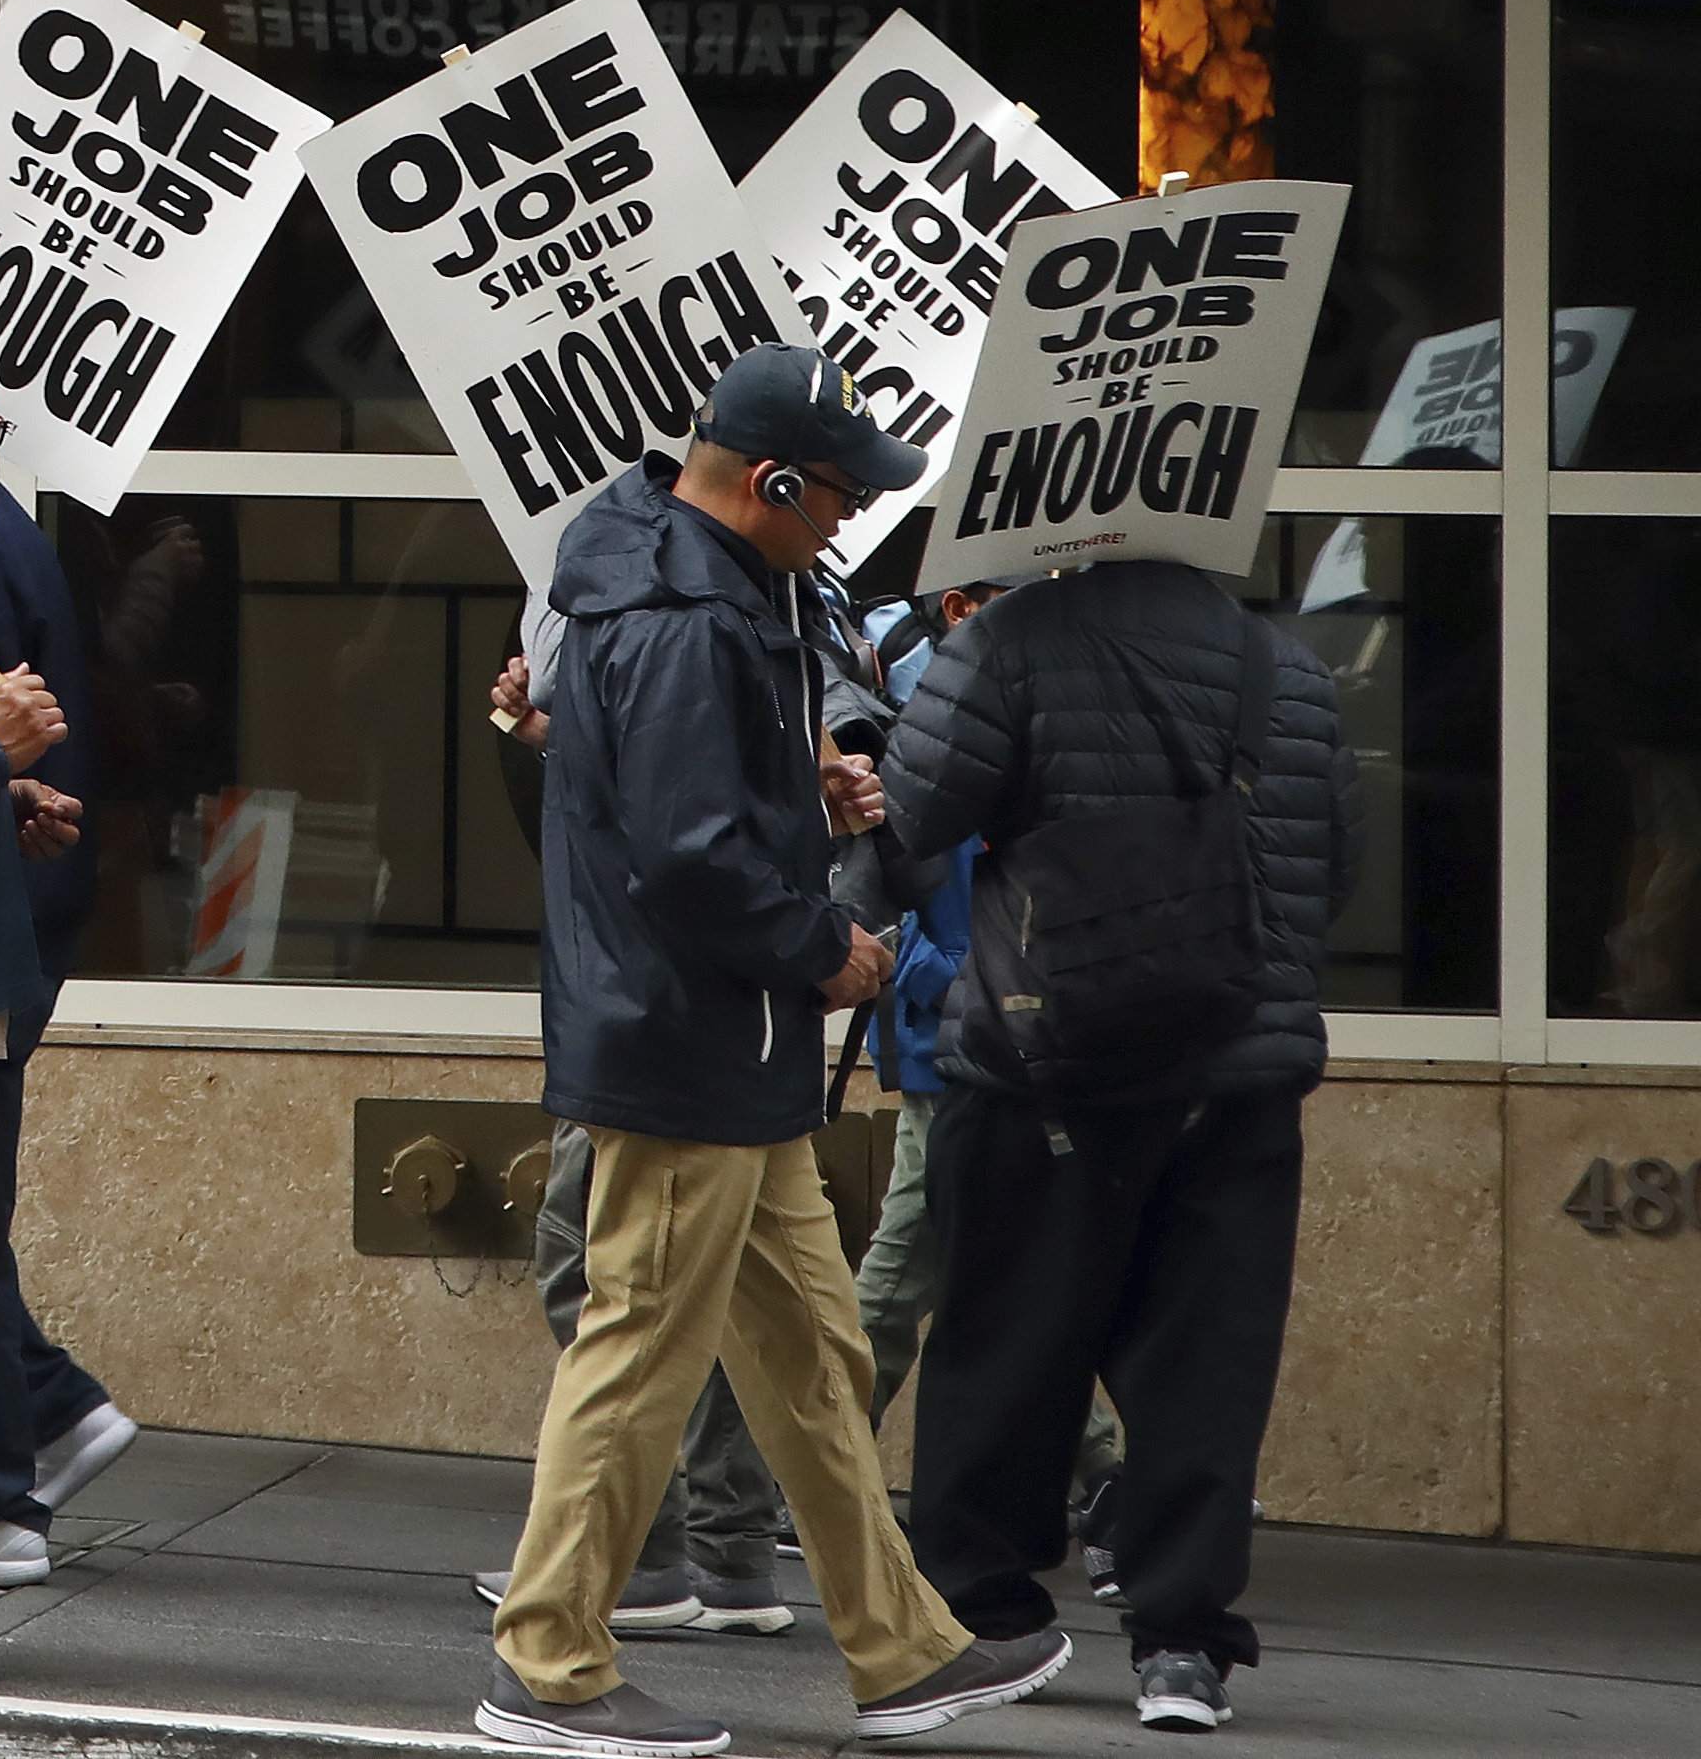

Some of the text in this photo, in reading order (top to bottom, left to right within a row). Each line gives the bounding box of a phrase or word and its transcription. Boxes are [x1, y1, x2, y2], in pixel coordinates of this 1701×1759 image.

[19, 10, 278, 199] ONE
[357, 32, 646, 233] ONE
[10, 157, 164, 259] SHOULD
[12, 110, 212, 235] JOB
[433, 132, 653, 277] JOB
[40, 219, 98, 269] BE
[479, 201, 652, 310] SHOULD
[824, 209, 964, 336] SHOULD
[838, 162, 1005, 318] JOB
[1025, 212, 1300, 310] ONE
[556, 264, 620, 319] BE
[841, 277, 897, 331] BE
[1040, 285, 1255, 353] JOB
[1053, 336, 1219, 385] SHOULD
[1098, 374, 1153, 408] BE
[955, 402, 1260, 539] ENOUGH
[1033, 533, 1127, 557] UNITEHERE!
